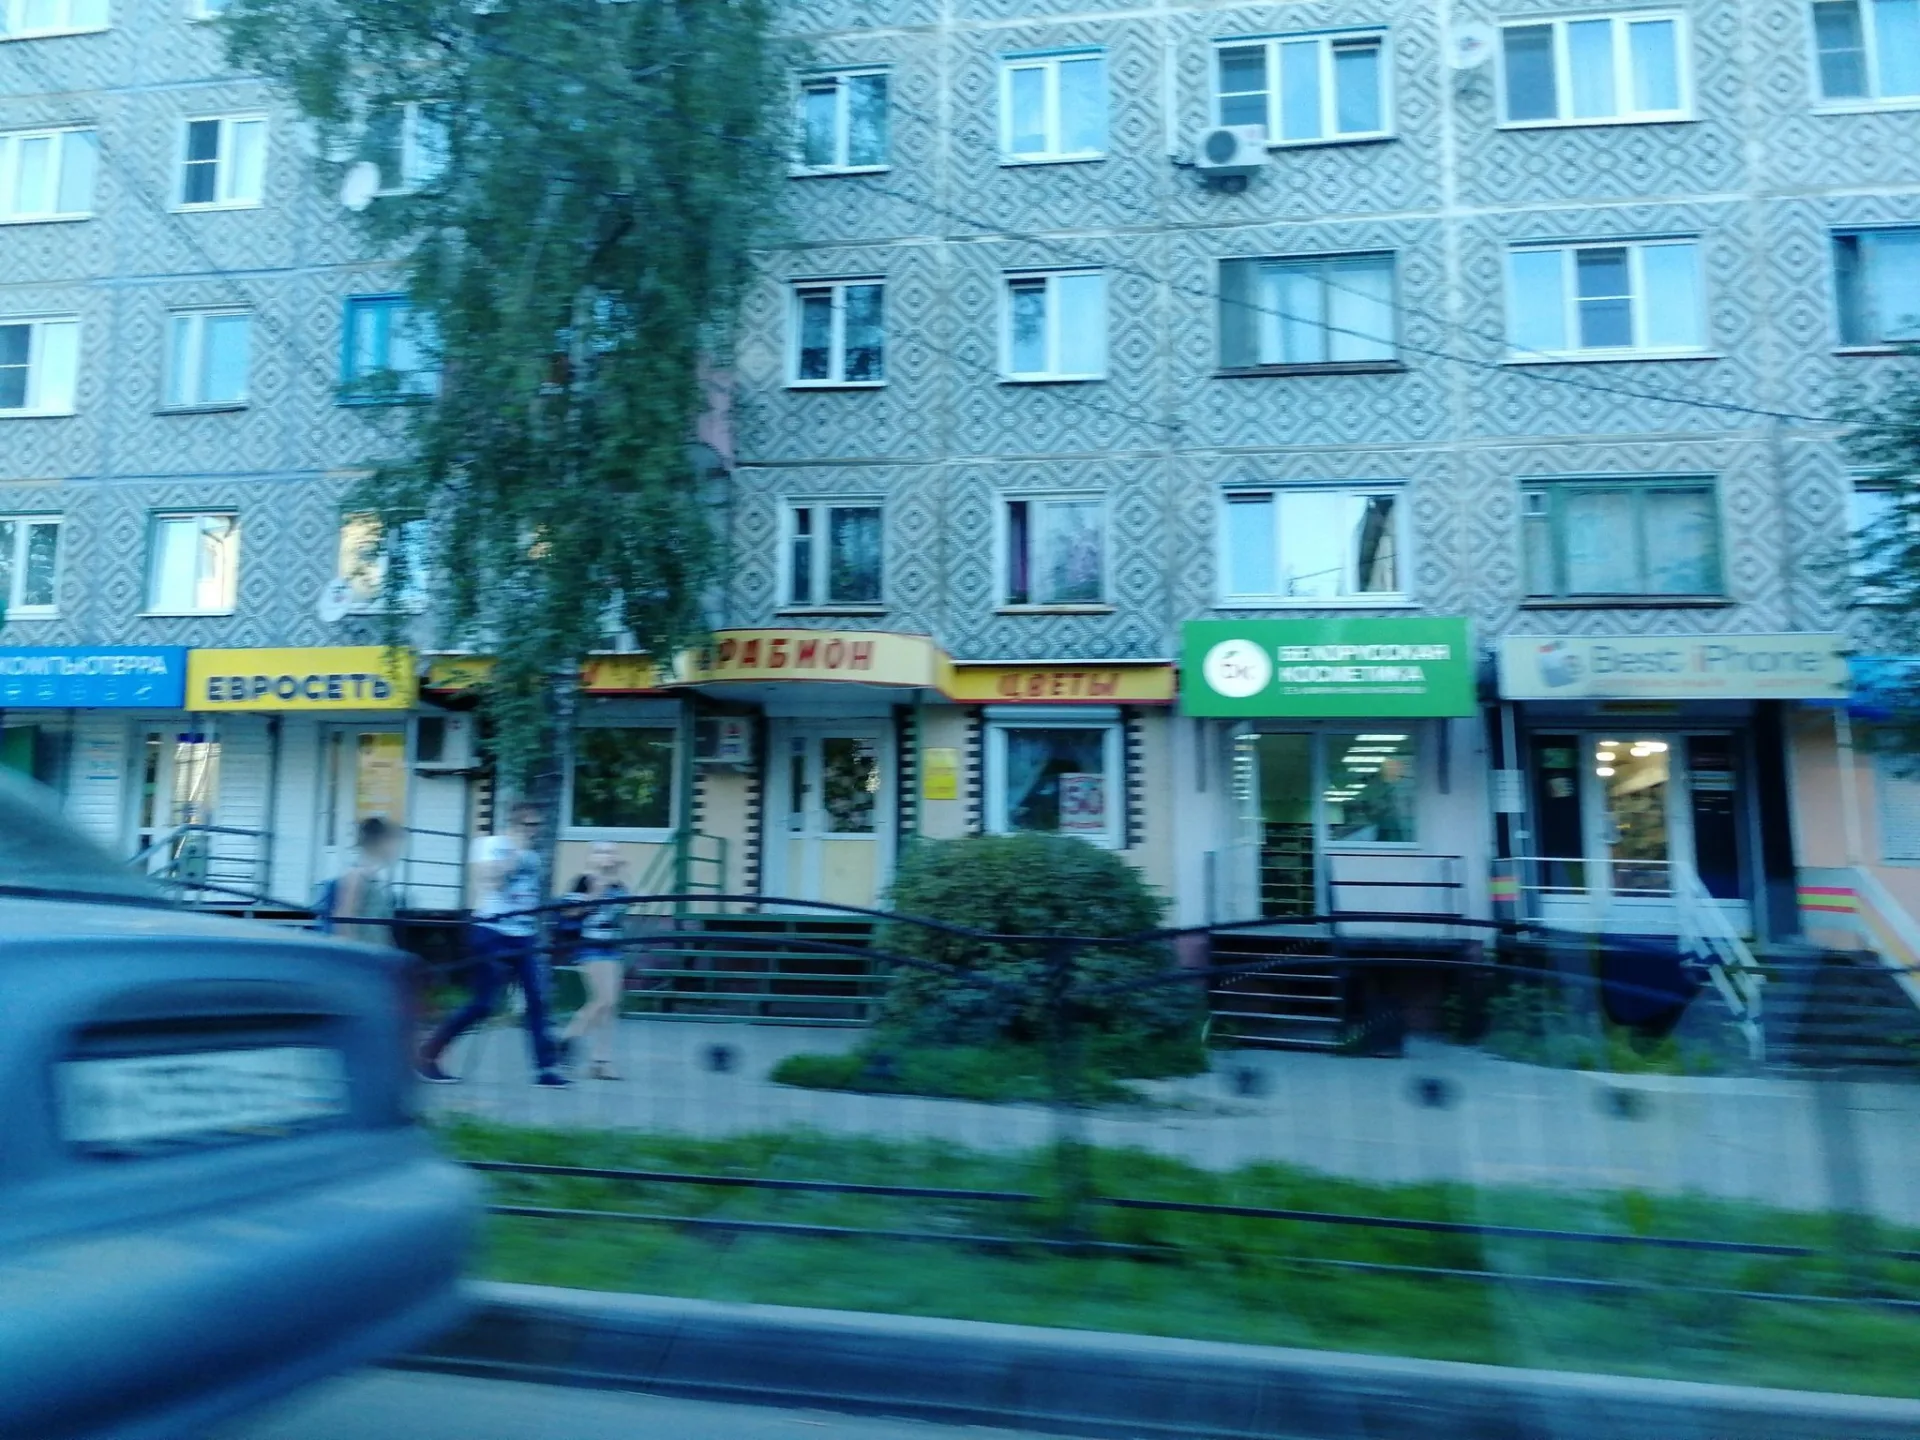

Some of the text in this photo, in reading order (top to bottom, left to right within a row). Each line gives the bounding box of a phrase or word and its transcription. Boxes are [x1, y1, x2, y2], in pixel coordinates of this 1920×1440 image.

[1590, 645, 1682, 674] Best
[206, 673, 392, 702] ЕВРОСЕТЬ
[996, 672, 1122, 698] ЦВЕТЫ
